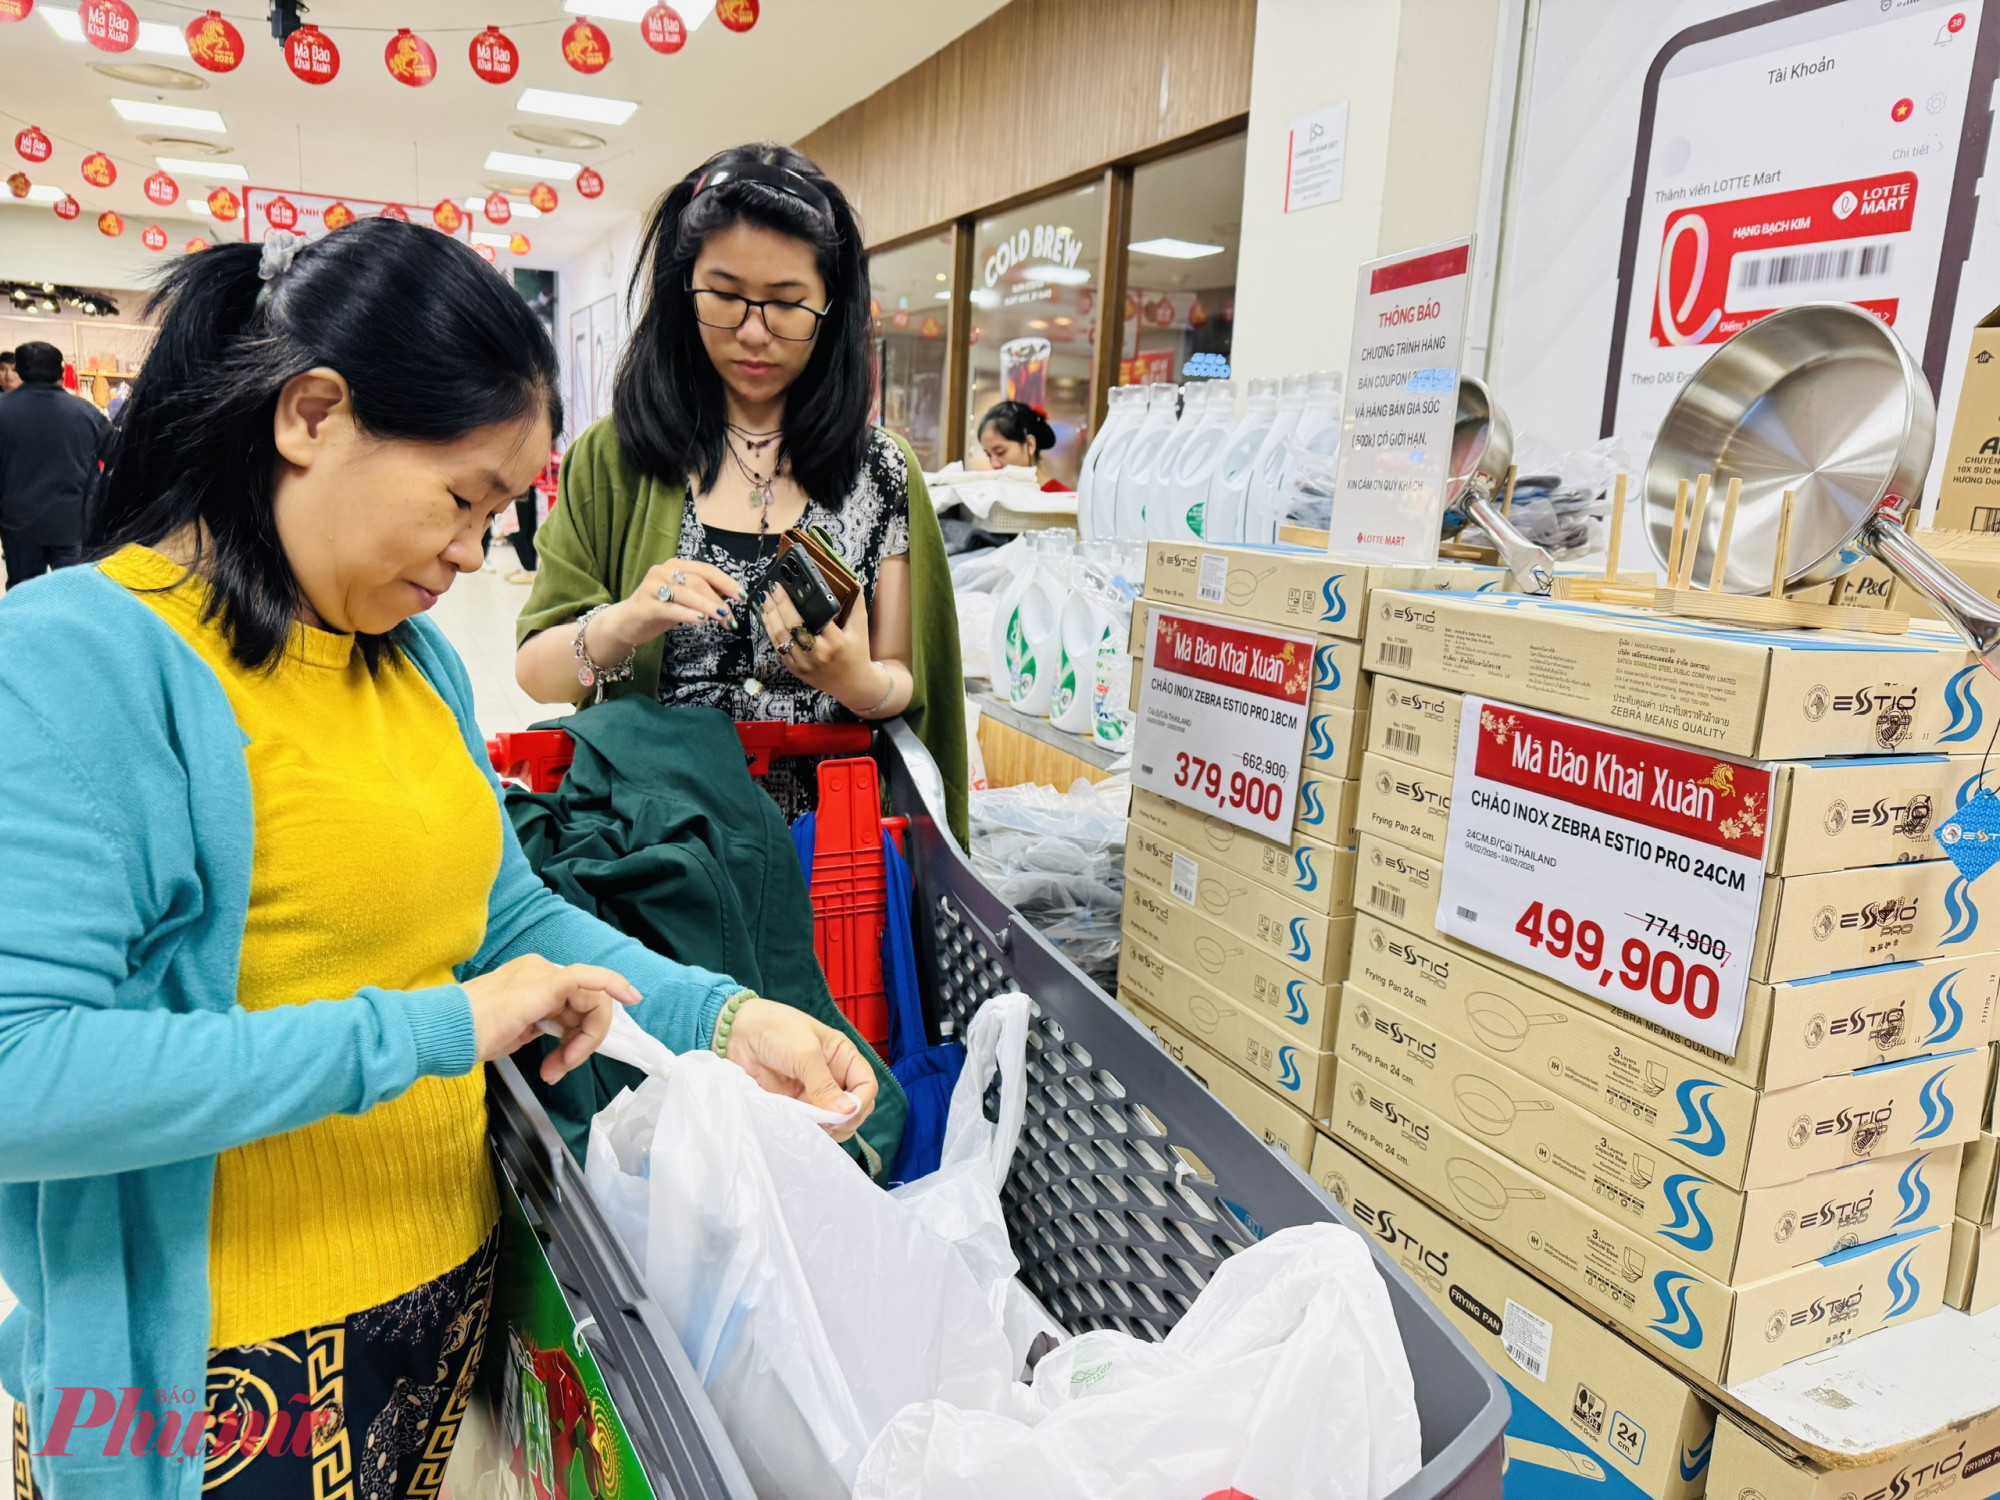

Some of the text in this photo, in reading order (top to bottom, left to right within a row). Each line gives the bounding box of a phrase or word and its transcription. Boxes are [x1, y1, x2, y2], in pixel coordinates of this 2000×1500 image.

[1767, 56, 1835, 85] Tài Khoản
[1892, 146, 1910, 161] Chi
[1655, 170, 1781, 204] Thành viên LOTTE Mart
[1862, 182, 1911, 201] LOTTE
[1860, 196, 1909, 216] MART
[1733, 216, 1811, 240] HẠNG BẠCH KIM
[984, 224, 1083, 288] COLD BREW
[1379, 297, 1441, 328] THÔNG BÁO
[1361, 334, 1446, 362] CHƯƠNG TRÌNH HÀNG
[1979, 354, 1990, 363] UP
[1374, 372, 1406, 388] COUPON
[1630, 373, 1655, 386] Theo
[1355, 397, 1440, 418] VÀ HÀNG BÁN GIÁ SỐC
[1952, 475, 1983, 485] HƯƠNG
[1957, 465, 1992, 475] 10X SỨC
[1363, 534, 1406, 546] LOTTE MART
[1174, 632, 1285, 684] Mã Đáo Khai Xuân
[1151, 676, 1298, 730] CHẢO INOX ZEBRA ESTIO PRO 18CM
[1610, 705, 1727, 741] ZEBRA MEANS QUALITY
[1242, 752, 1286, 779] 662,900
[1512, 731, 1714, 822] Mã Đáo Khai Xuân
[1174, 751, 1283, 821] 379,900
[1372, 812, 1436, 842] Frying Pan 24 cm.
[1471, 790, 1746, 892] CHẢO INOX ZEBRA ESTIO PRO 24CM
[1514, 843, 1557, 868] THAILAND
[1645, 912, 1726, 960] 774,900
[1515, 900, 1720, 1020] 499,900
[1365, 967, 1428, 1007] Frying Pan 24 cm.
[1610, 1005, 1731, 1065] ZEBRA MEANS QUALITY
[1351, 1043, 1415, 1086] Frying Pan 24 cm.
[1614, 1046, 1621, 1057] 3
[1551, 1061, 1560, 1071] IH
[1346, 1120, 1410, 1167] Frying Pan 24 cm.
[1538, 1147, 1547, 1158] IH
[1600, 1137, 1608, 1148] 3
[1530, 1235, 1539, 1246] IH
[1592, 1229, 1599, 1240] 3
[1450, 1288, 1481, 1319] FRYING
[1482, 1310, 1500, 1332] PAN
[1570, 1417, 1599, 1443] Food Grade
[1617, 1422, 1637, 1448] 24
[1617, 1440, 1632, 1455] cm.
[1964, 1452, 1992, 1474] FRYING
